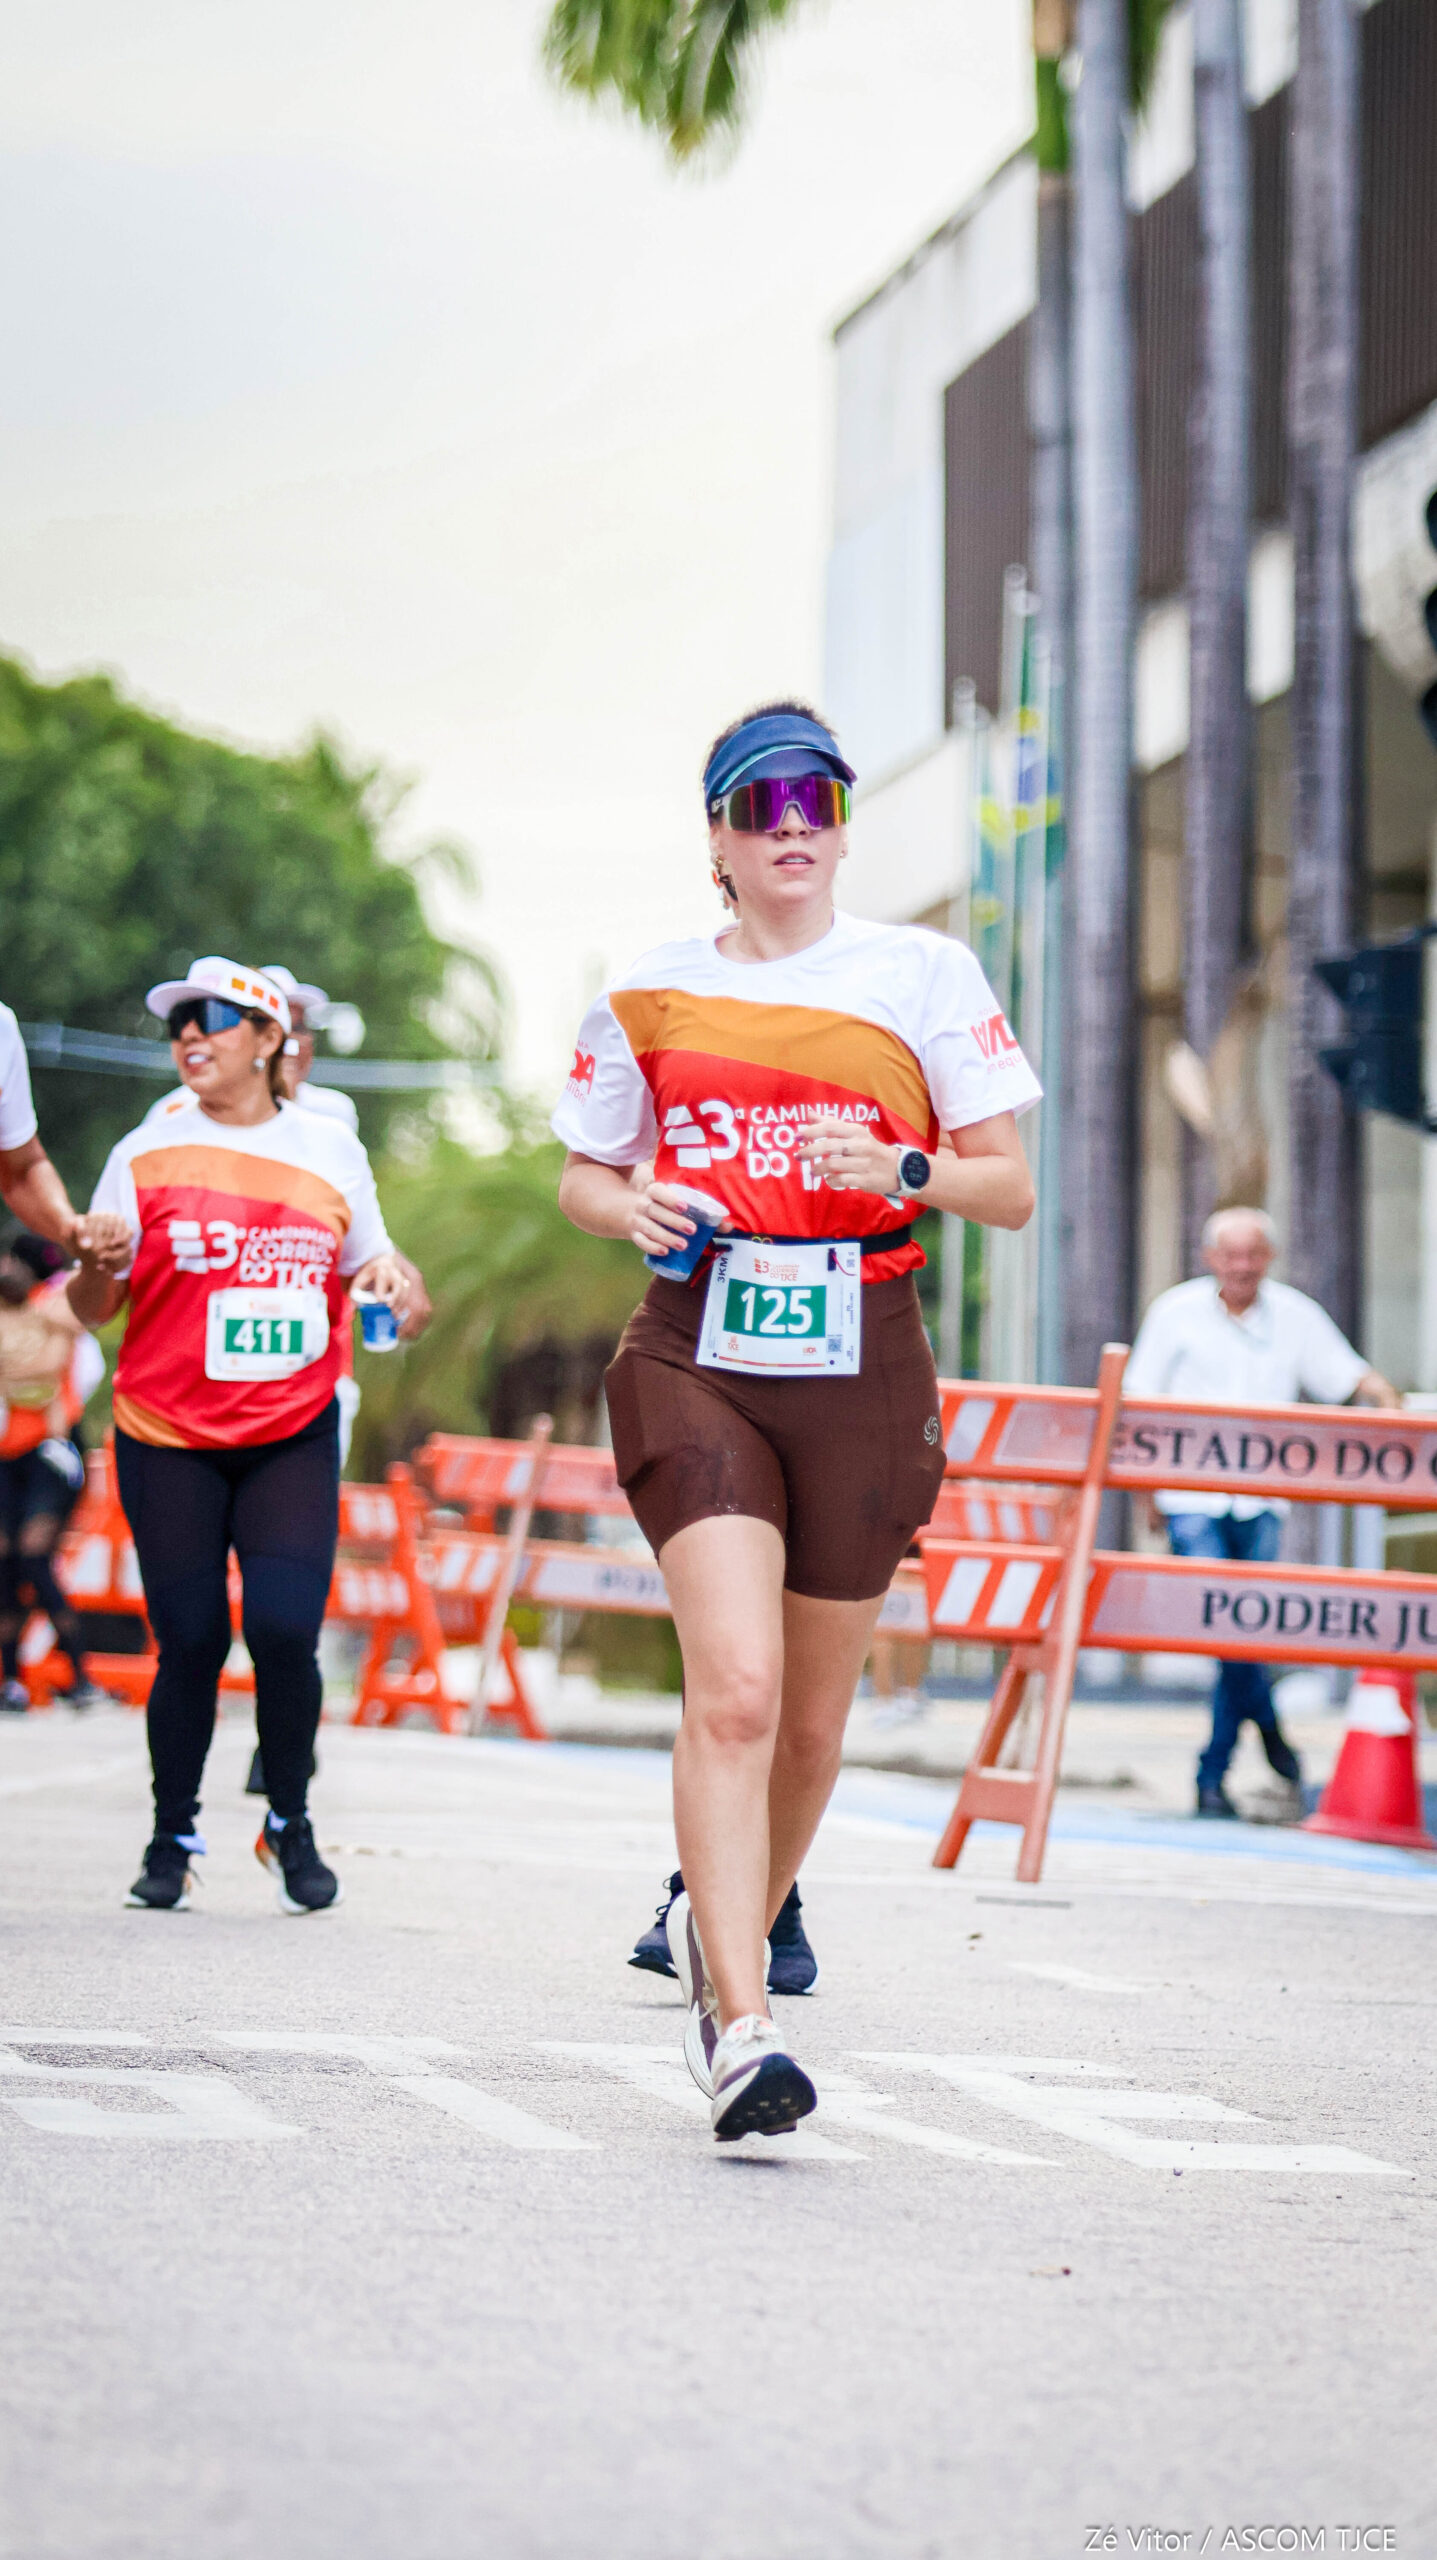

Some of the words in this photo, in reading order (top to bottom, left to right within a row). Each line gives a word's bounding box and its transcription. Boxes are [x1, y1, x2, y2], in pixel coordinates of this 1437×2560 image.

[747, 1150, 791, 1179] DO
[240, 1260, 273, 1282] DO
[717, 1257, 729, 1284] 3KM
[741, 1285, 813, 1335] 125
[233, 1320, 292, 1354] 411
[1110, 1421, 1318, 1478] ESTADO
[1335, 1438, 1415, 1484] DO
[1202, 1587, 1379, 1640] PODER
